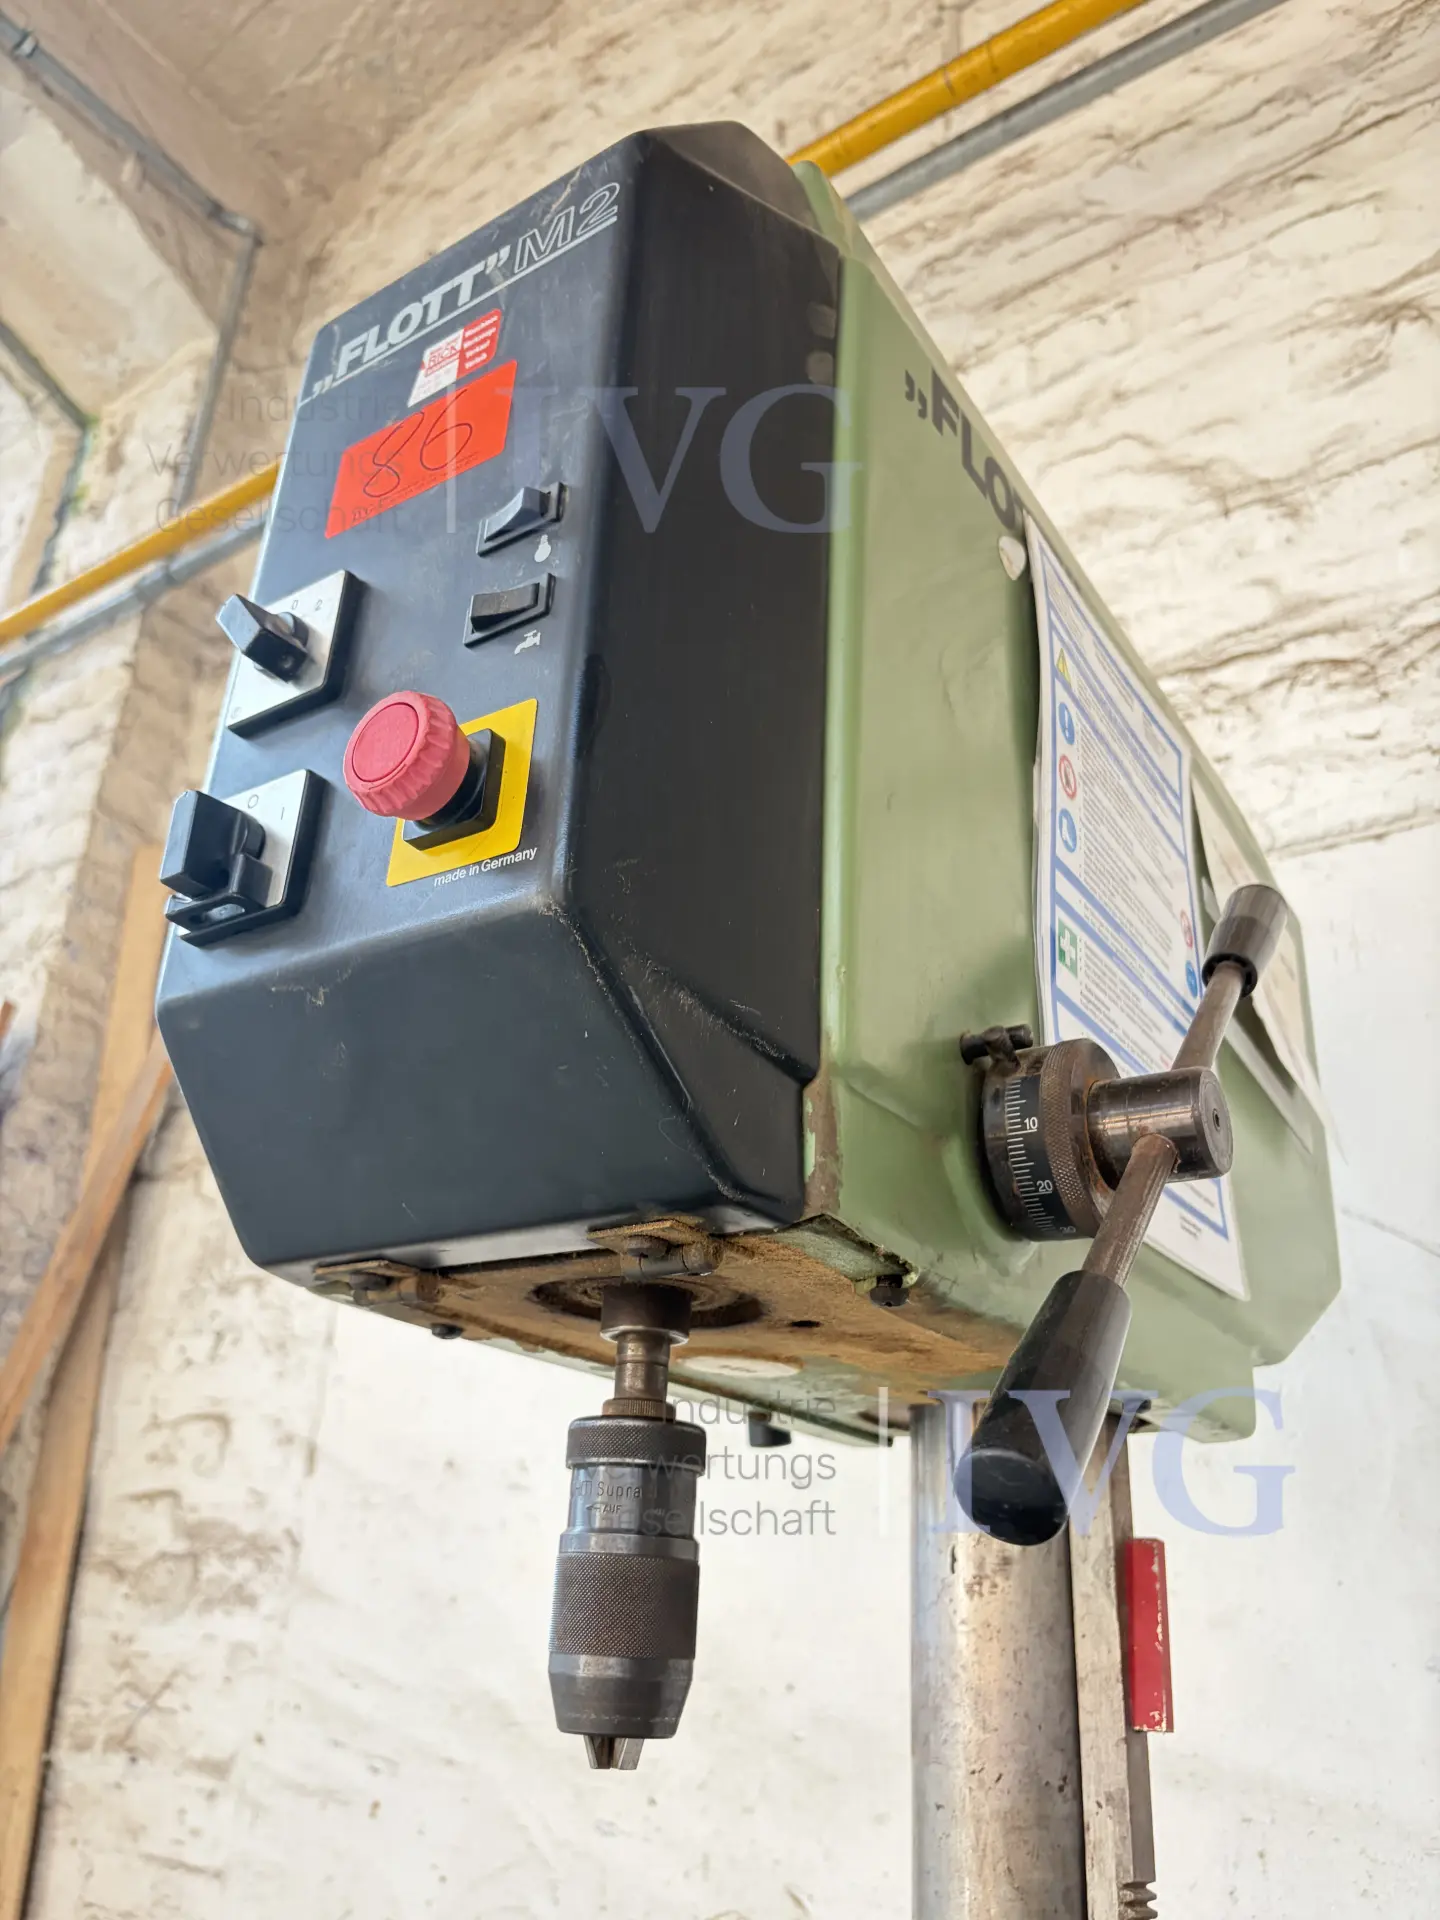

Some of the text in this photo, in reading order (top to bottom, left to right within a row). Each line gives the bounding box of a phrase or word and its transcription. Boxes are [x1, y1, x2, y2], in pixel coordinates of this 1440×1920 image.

[514, 182, 620, 273] M2
[362, 388, 473, 498] 86
[433, 847, 538, 887] made in Germany
[1024, 1117, 1038, 1130] 10
[1036, 1180, 1053, 1192] 20
[597, 1481, 642, 1500] Supra
